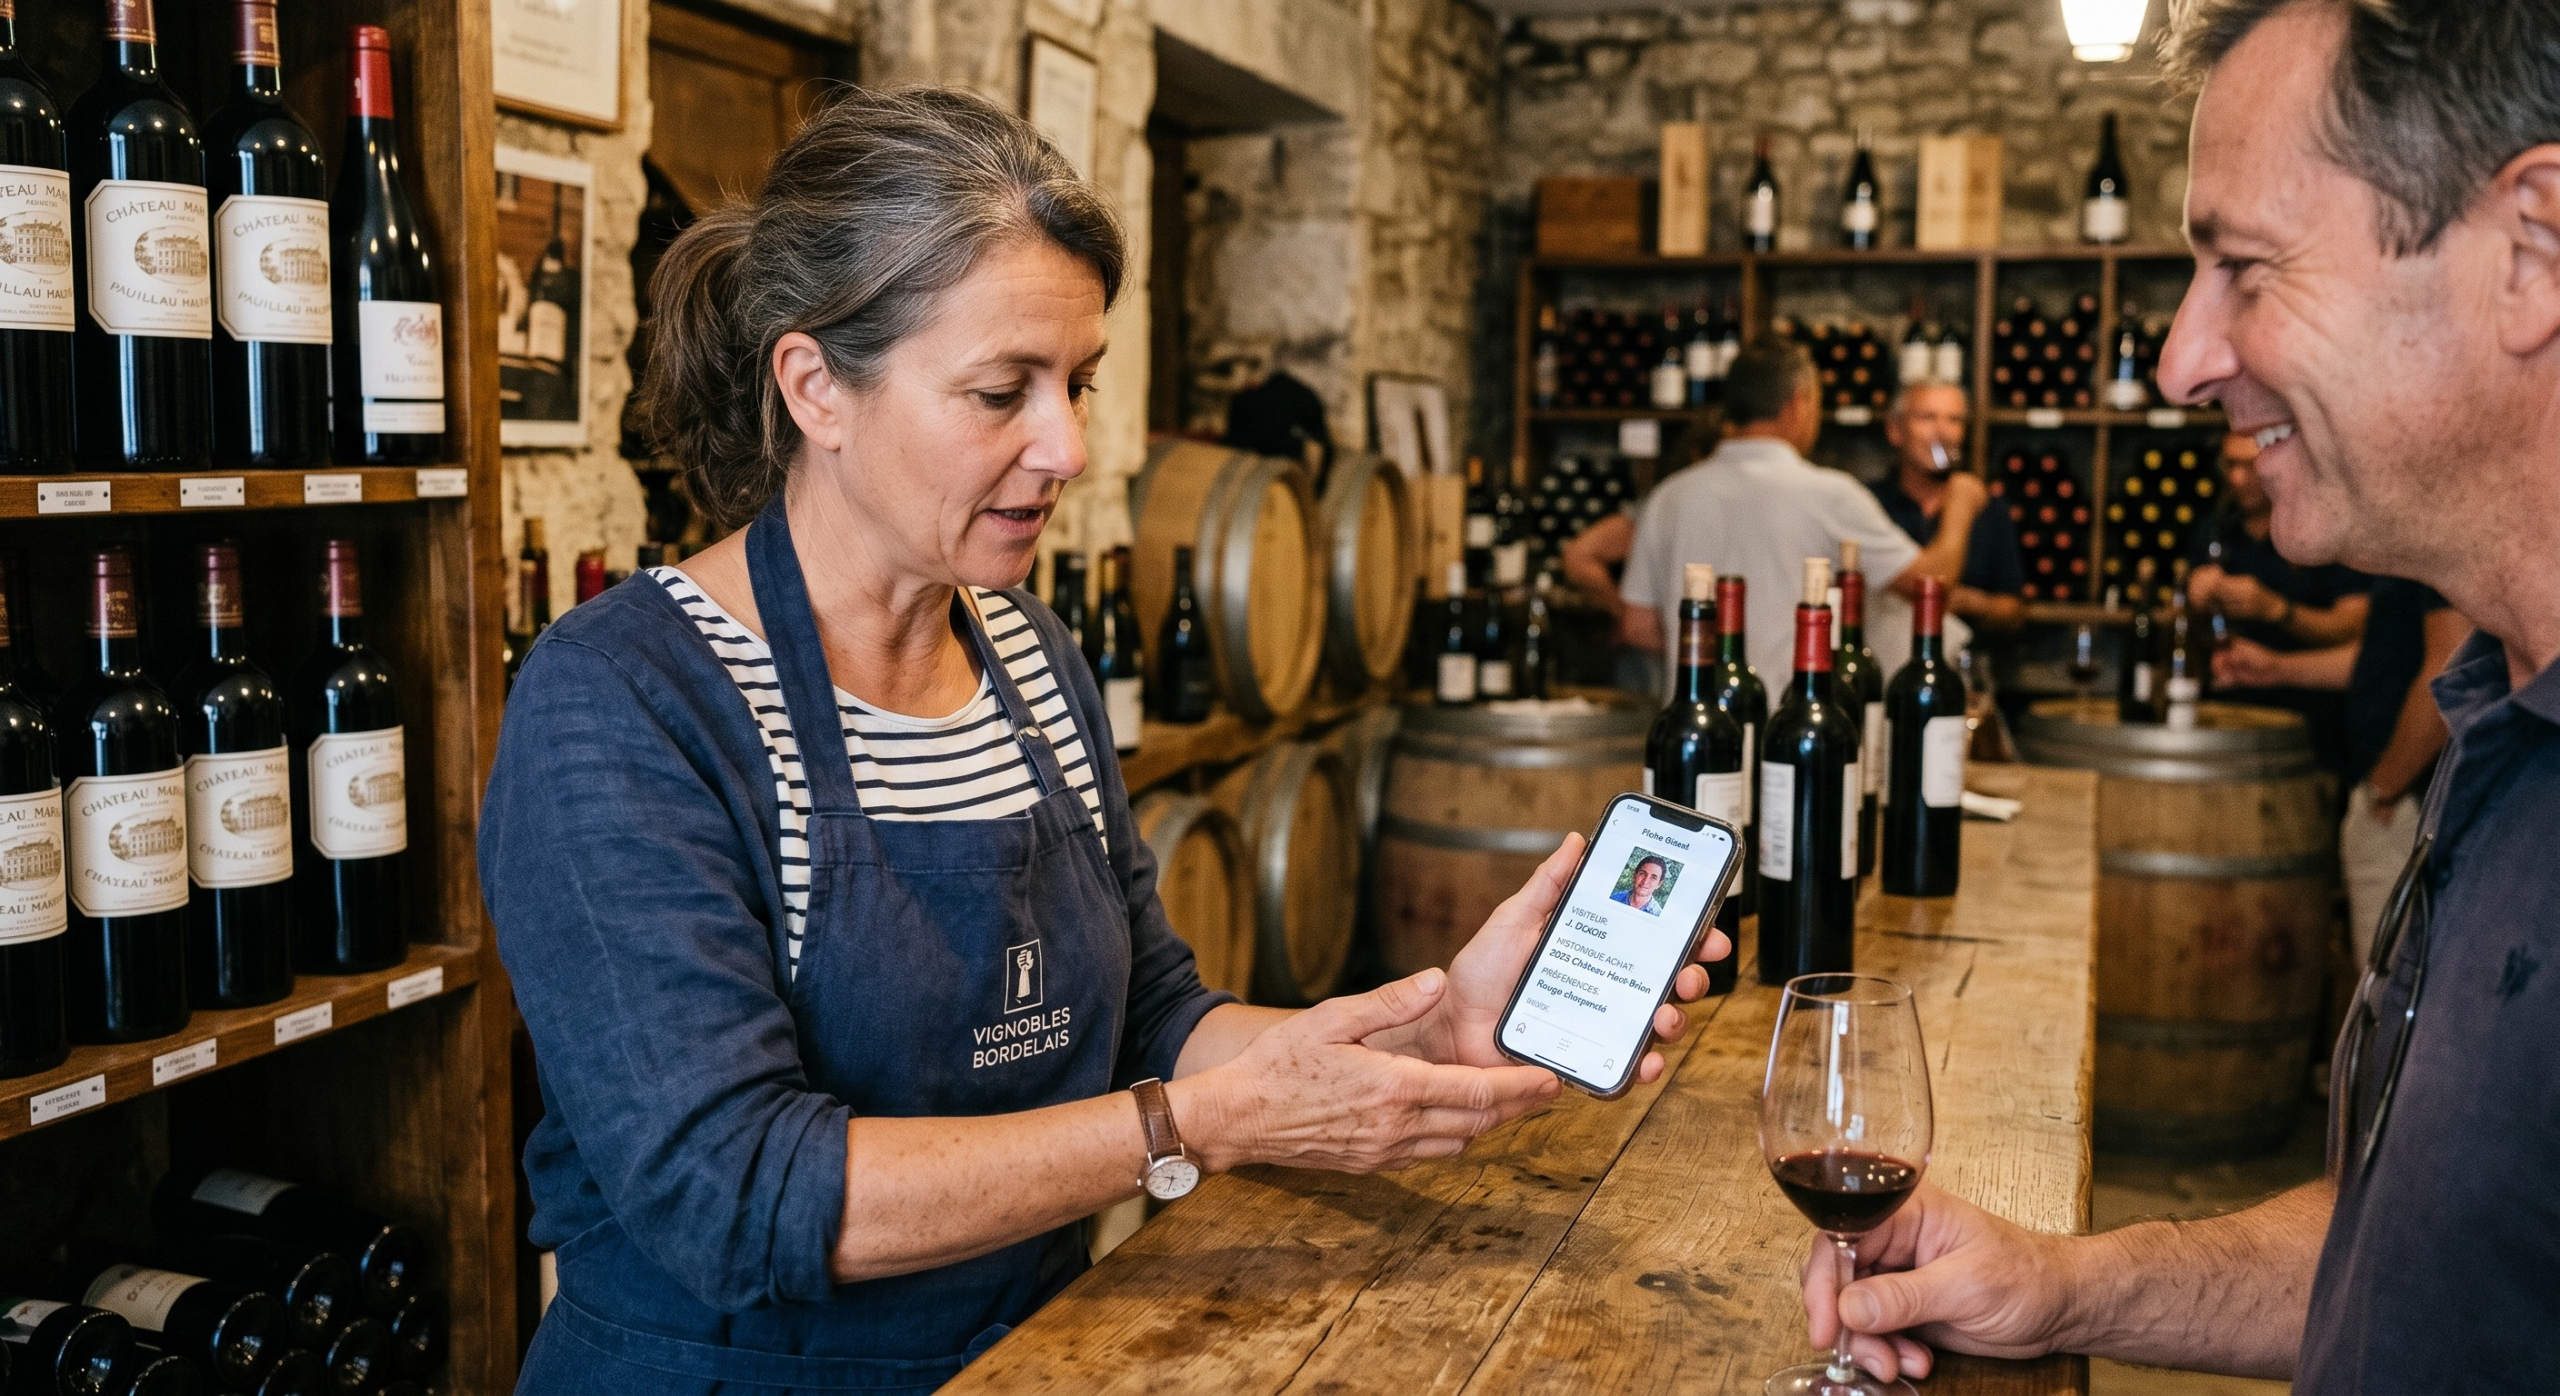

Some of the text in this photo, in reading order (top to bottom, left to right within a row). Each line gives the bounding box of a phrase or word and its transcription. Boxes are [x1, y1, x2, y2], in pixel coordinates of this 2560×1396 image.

[110, 281, 177, 307] PAUILLAU
[1565, 918, 1573, 928] J.
[973, 1006, 1071, 1046] VIGNOBLES
[973, 1029, 1070, 1069] BORDELAIS
